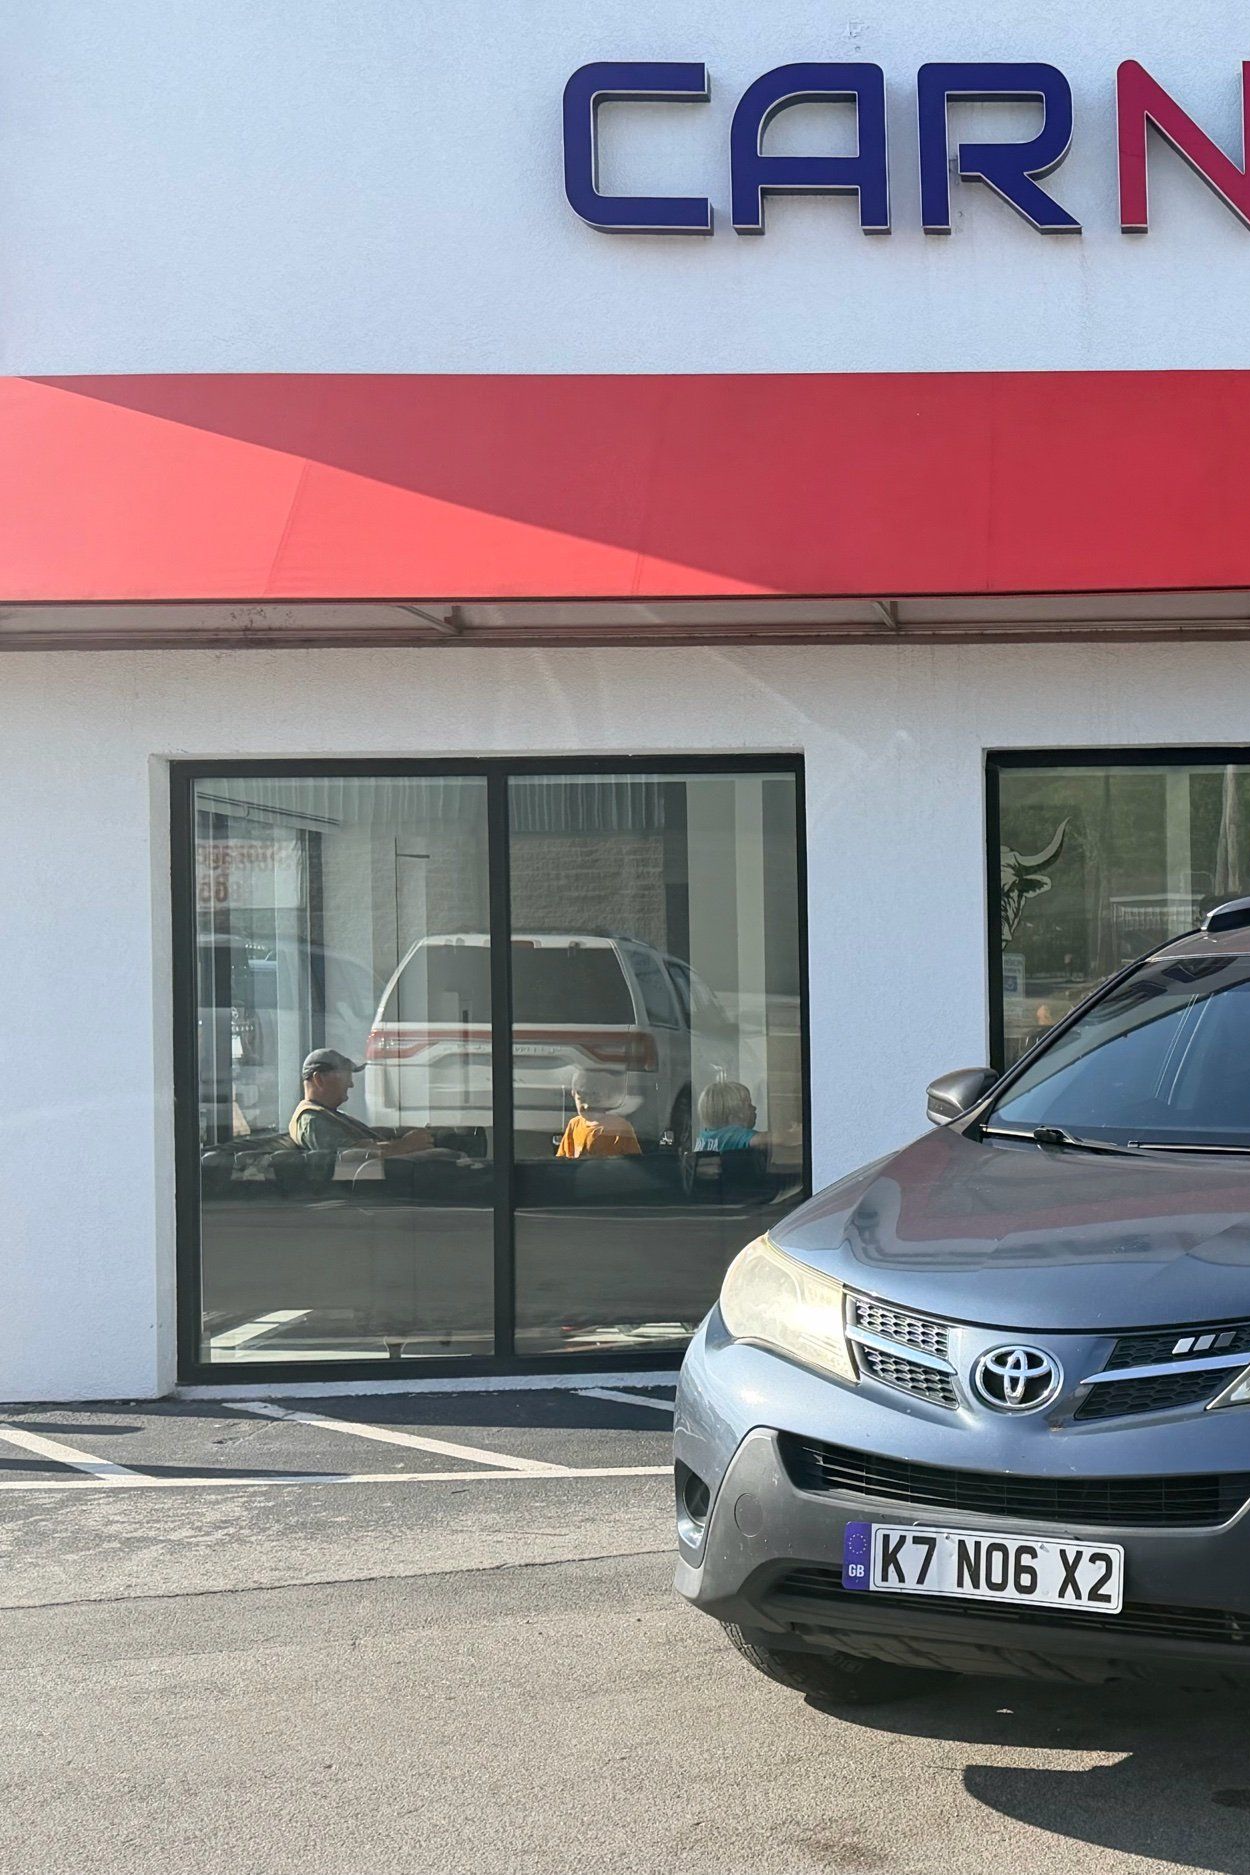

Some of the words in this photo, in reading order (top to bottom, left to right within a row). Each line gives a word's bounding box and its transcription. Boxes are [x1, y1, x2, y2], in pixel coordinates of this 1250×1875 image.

[848, 1564, 865, 1578] GB
[881, 1534, 937, 1585] K7
[1057, 1548, 1113, 1603] X2
